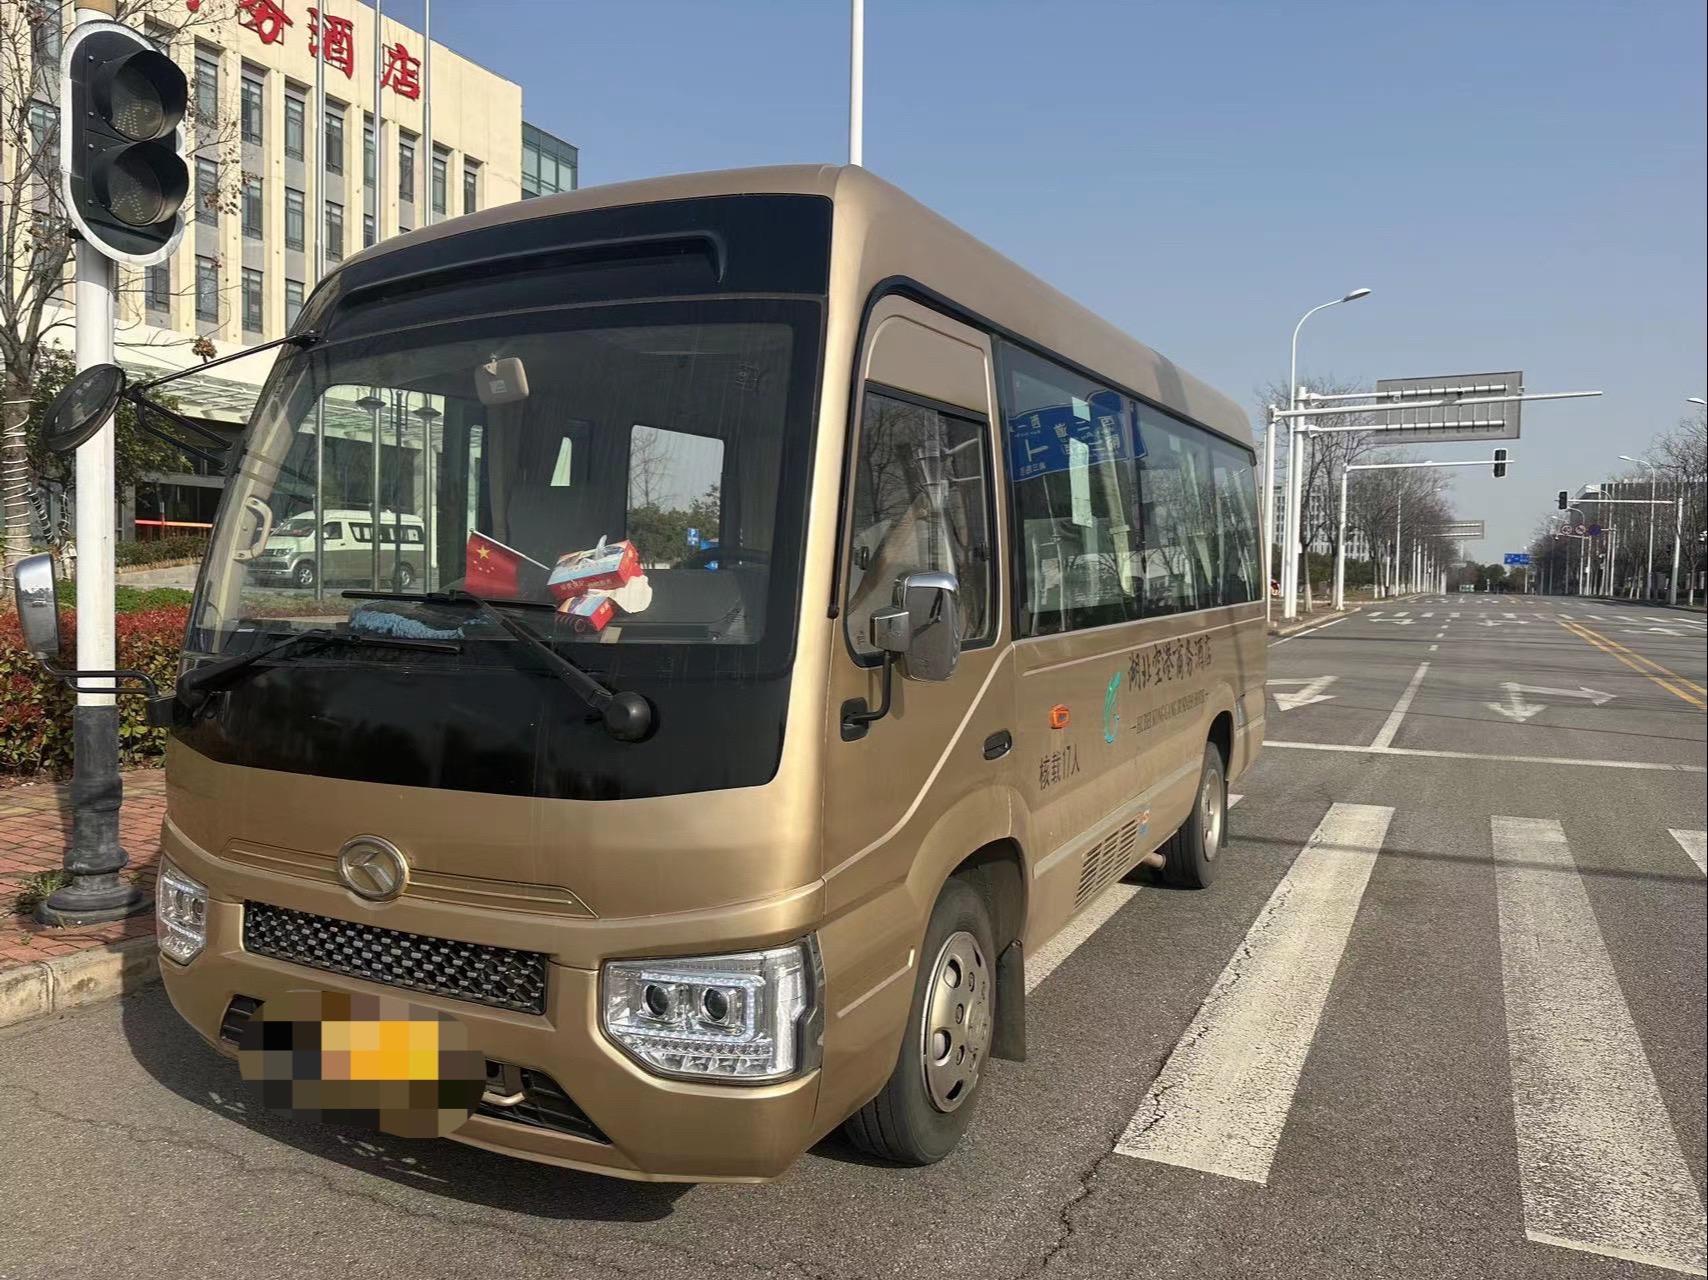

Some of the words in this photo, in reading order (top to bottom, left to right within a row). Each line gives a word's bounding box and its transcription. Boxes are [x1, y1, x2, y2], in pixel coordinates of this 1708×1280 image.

[186, 0, 421, 100] 务酒店
[1039, 744, 1080, 791] 核载17人
